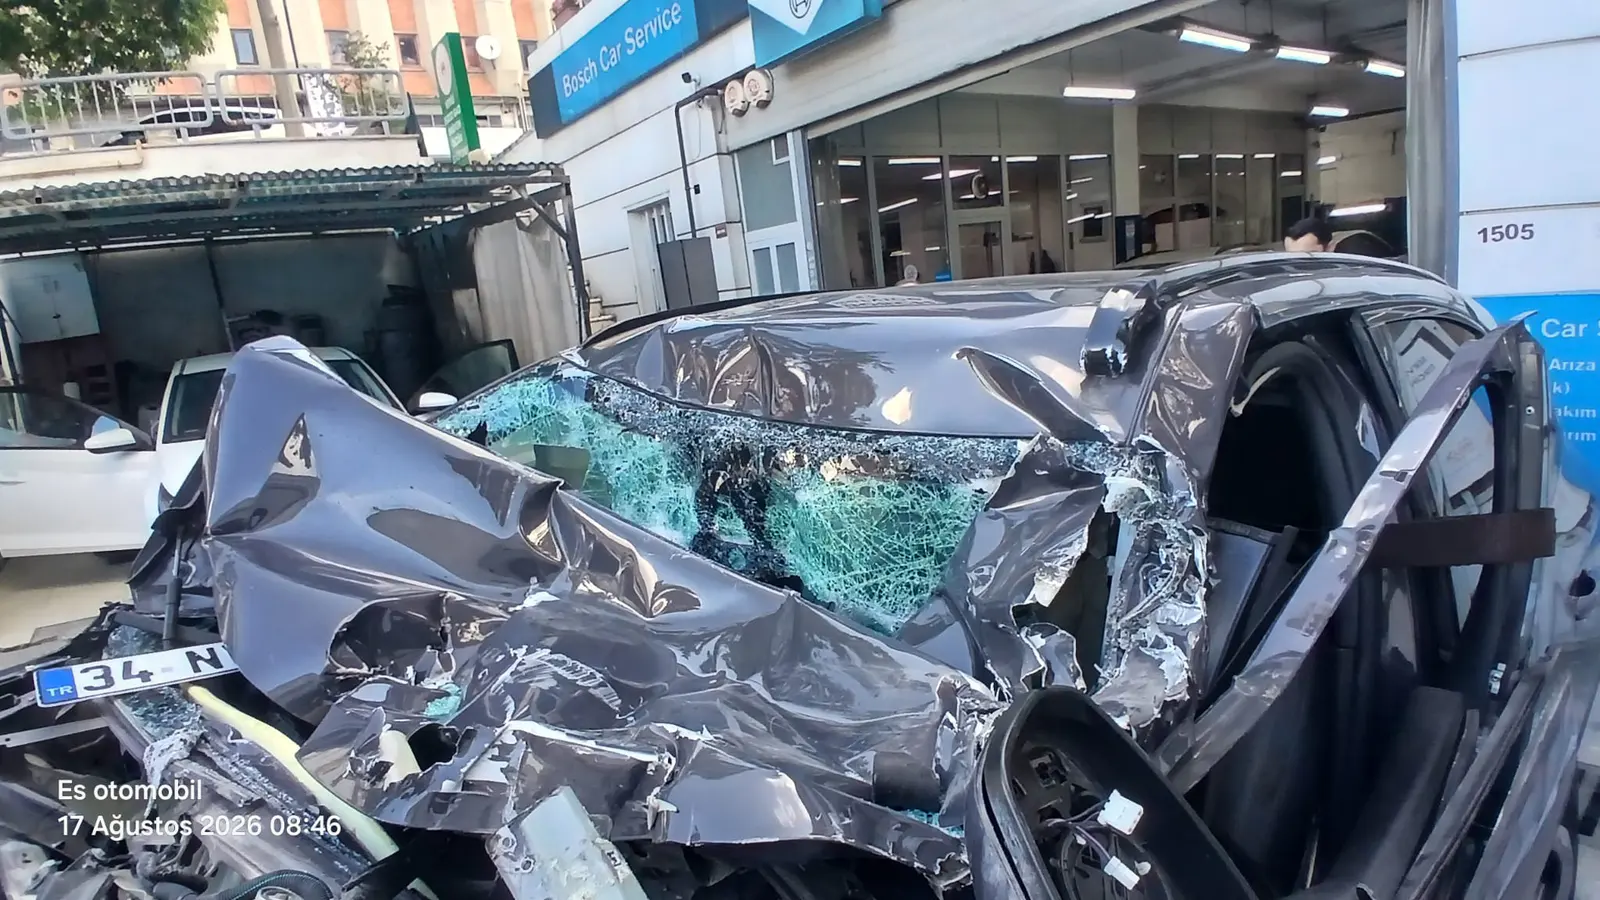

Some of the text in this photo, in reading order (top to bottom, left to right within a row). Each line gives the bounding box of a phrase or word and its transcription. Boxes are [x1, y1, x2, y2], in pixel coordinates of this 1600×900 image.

[562, 2, 682, 98] Bosch Car Service
[1477, 223, 1534, 243] 1505
[1541, 318, 1588, 338] Car
[1549, 358, 1596, 371] Arıza
[1552, 381, 1571, 394] k)
[1554, 405, 1597, 418] akım
[1564, 431, 1597, 441] rım
[47, 647, 223, 696] TR 34 N
